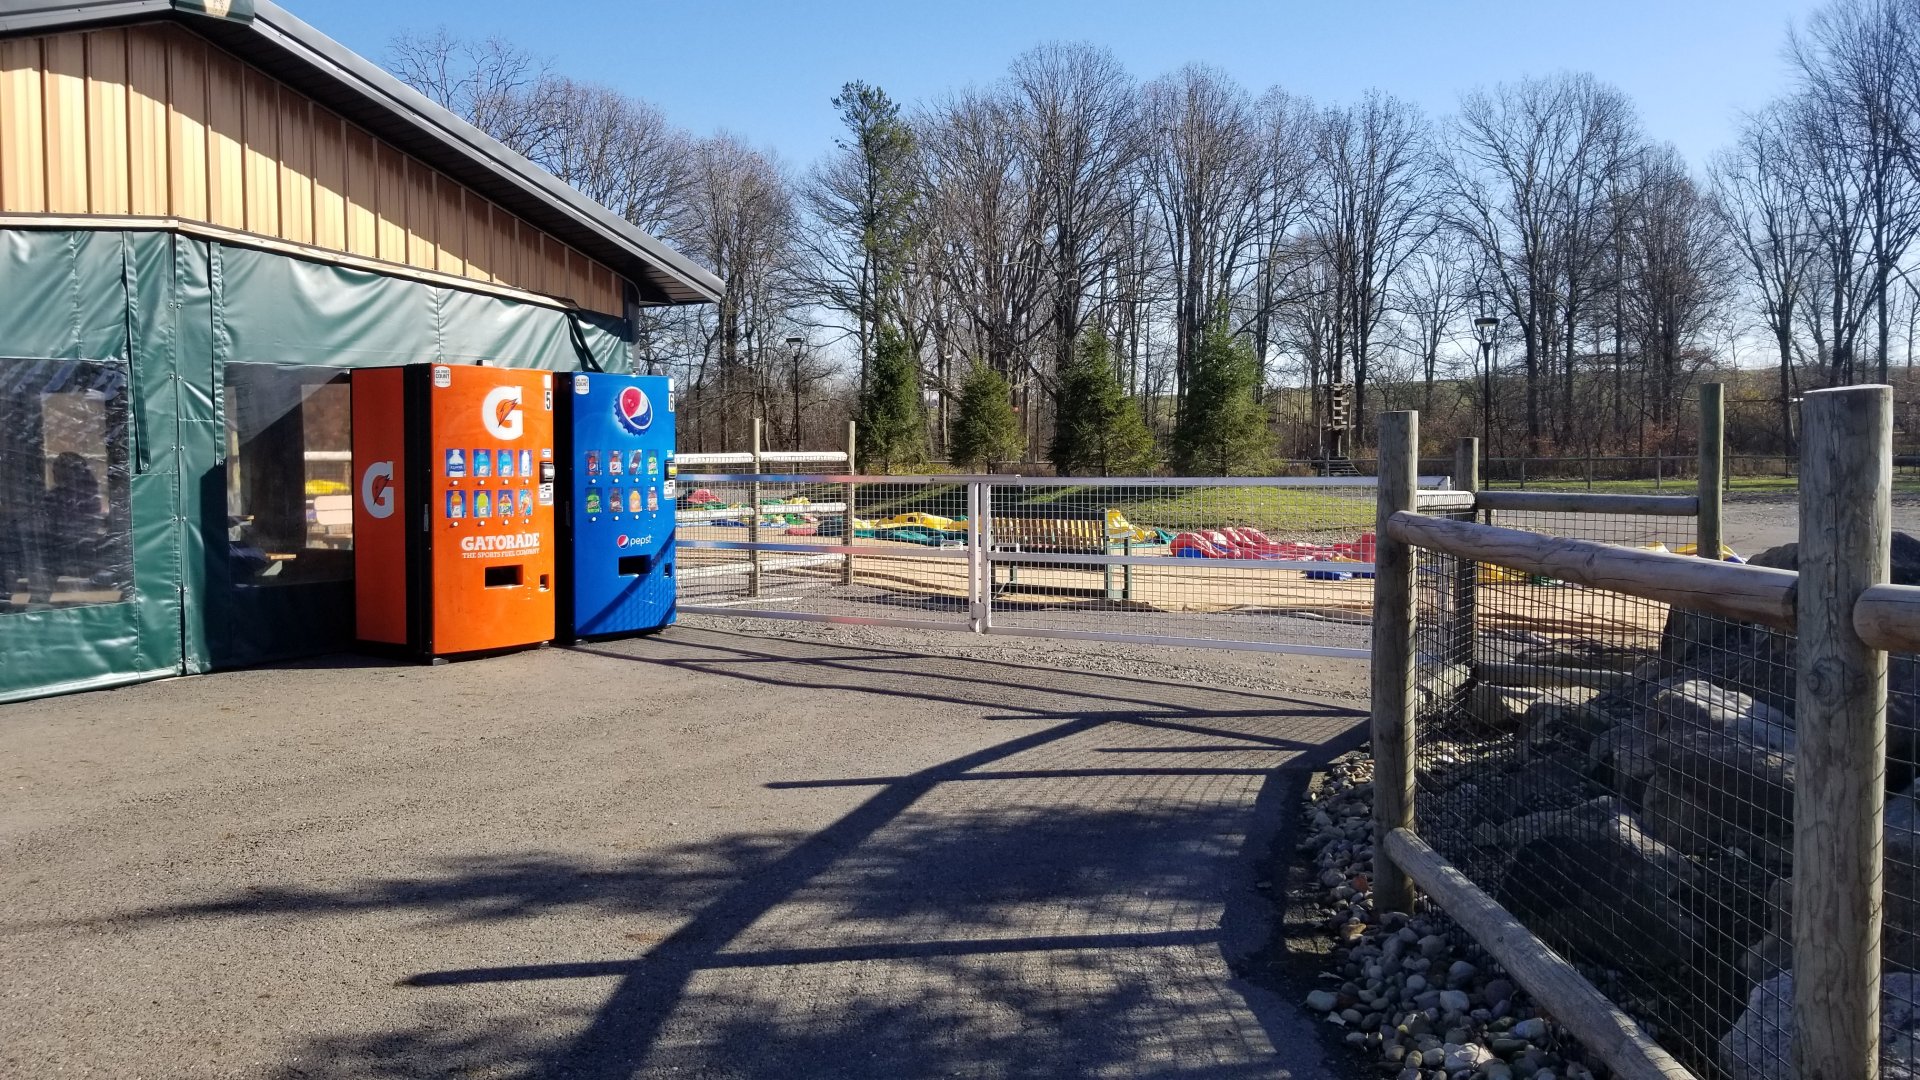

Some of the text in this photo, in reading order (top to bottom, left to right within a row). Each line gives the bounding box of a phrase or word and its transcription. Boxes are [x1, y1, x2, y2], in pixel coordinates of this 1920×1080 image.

[545, 391, 552, 410] 5
[669, 394, 674, 411] 6
[482, 385, 524, 440] G
[362, 461, 395, 519] G
[461, 532, 540, 551] GATORADE
[516, 548, 540, 556] COMPANY
